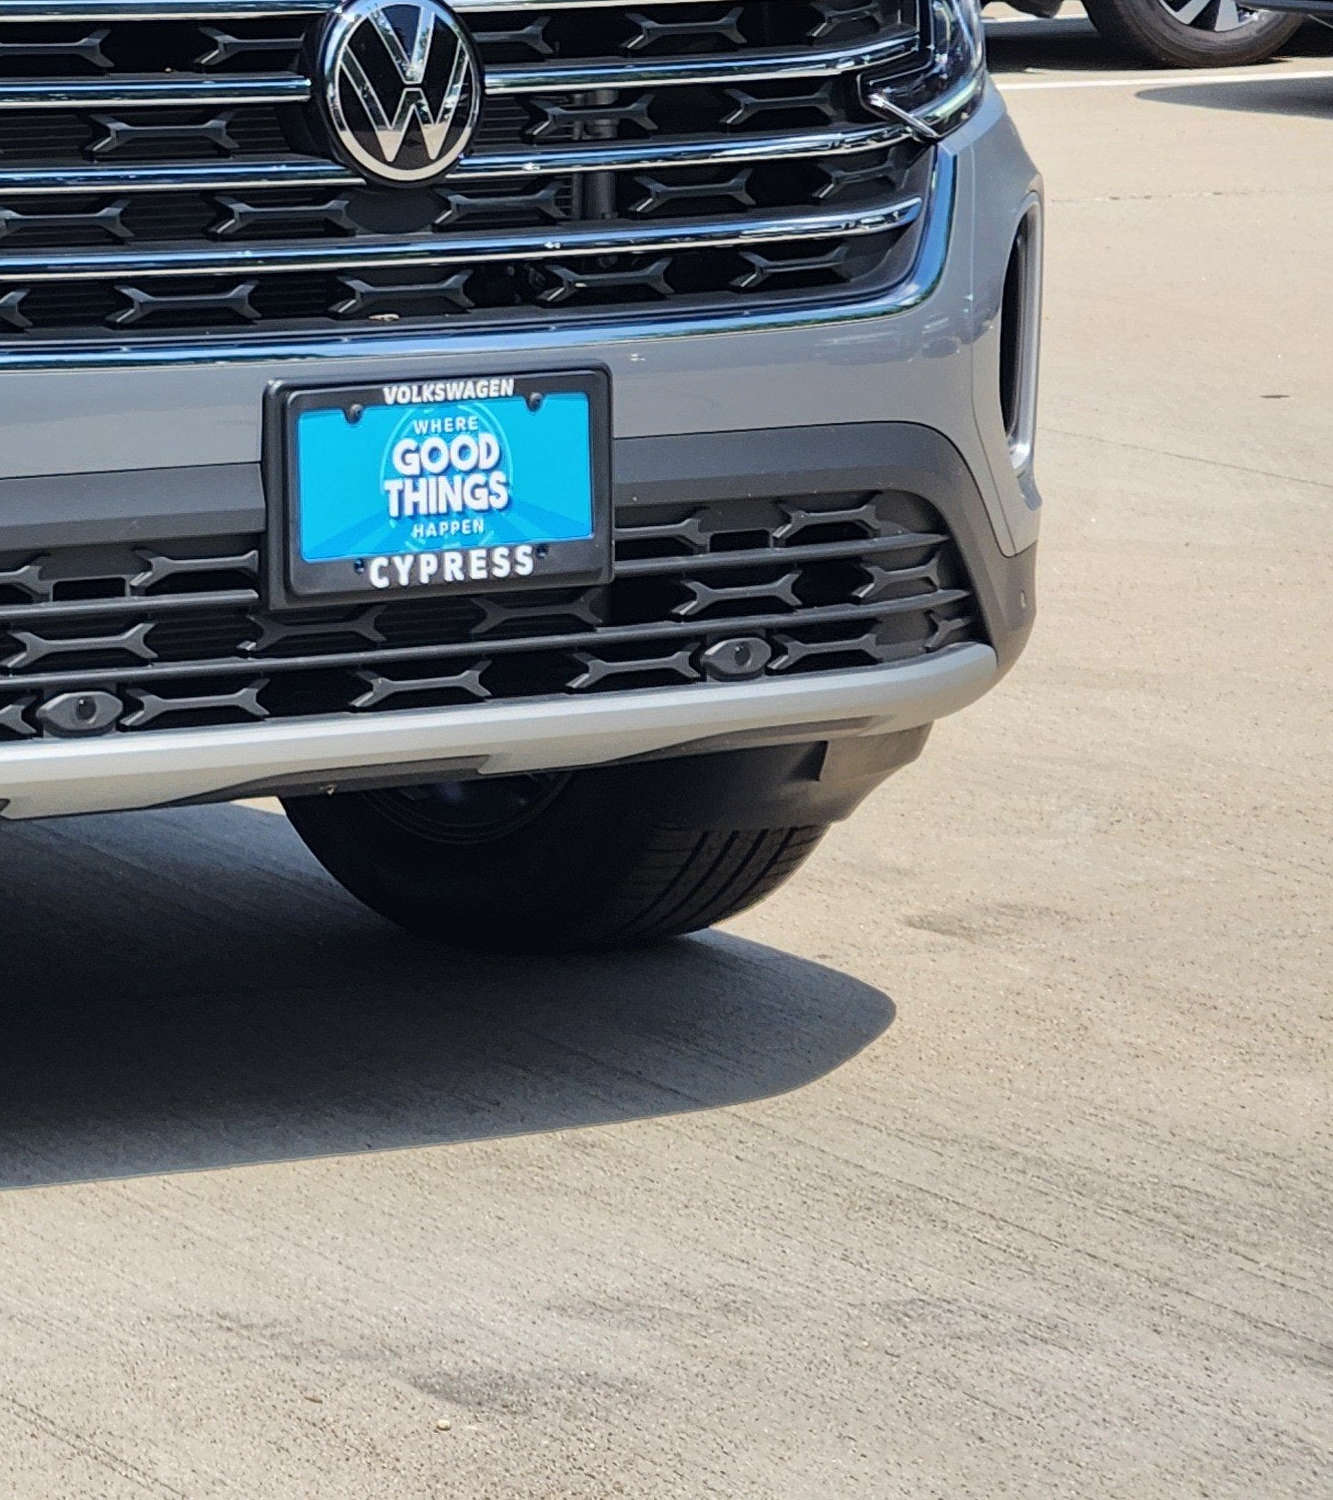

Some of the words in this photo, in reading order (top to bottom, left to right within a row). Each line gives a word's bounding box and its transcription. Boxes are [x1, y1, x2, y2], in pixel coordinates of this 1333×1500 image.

[383, 379, 515, 405] VOLKSWAGEN
[413, 417, 479, 434] WHERE
[392, 434, 500, 475] GOOD
[384, 474, 509, 517] THINGS
[413, 519, 484, 538] HAPPEN
[369, 545, 535, 589] CYPRESS
